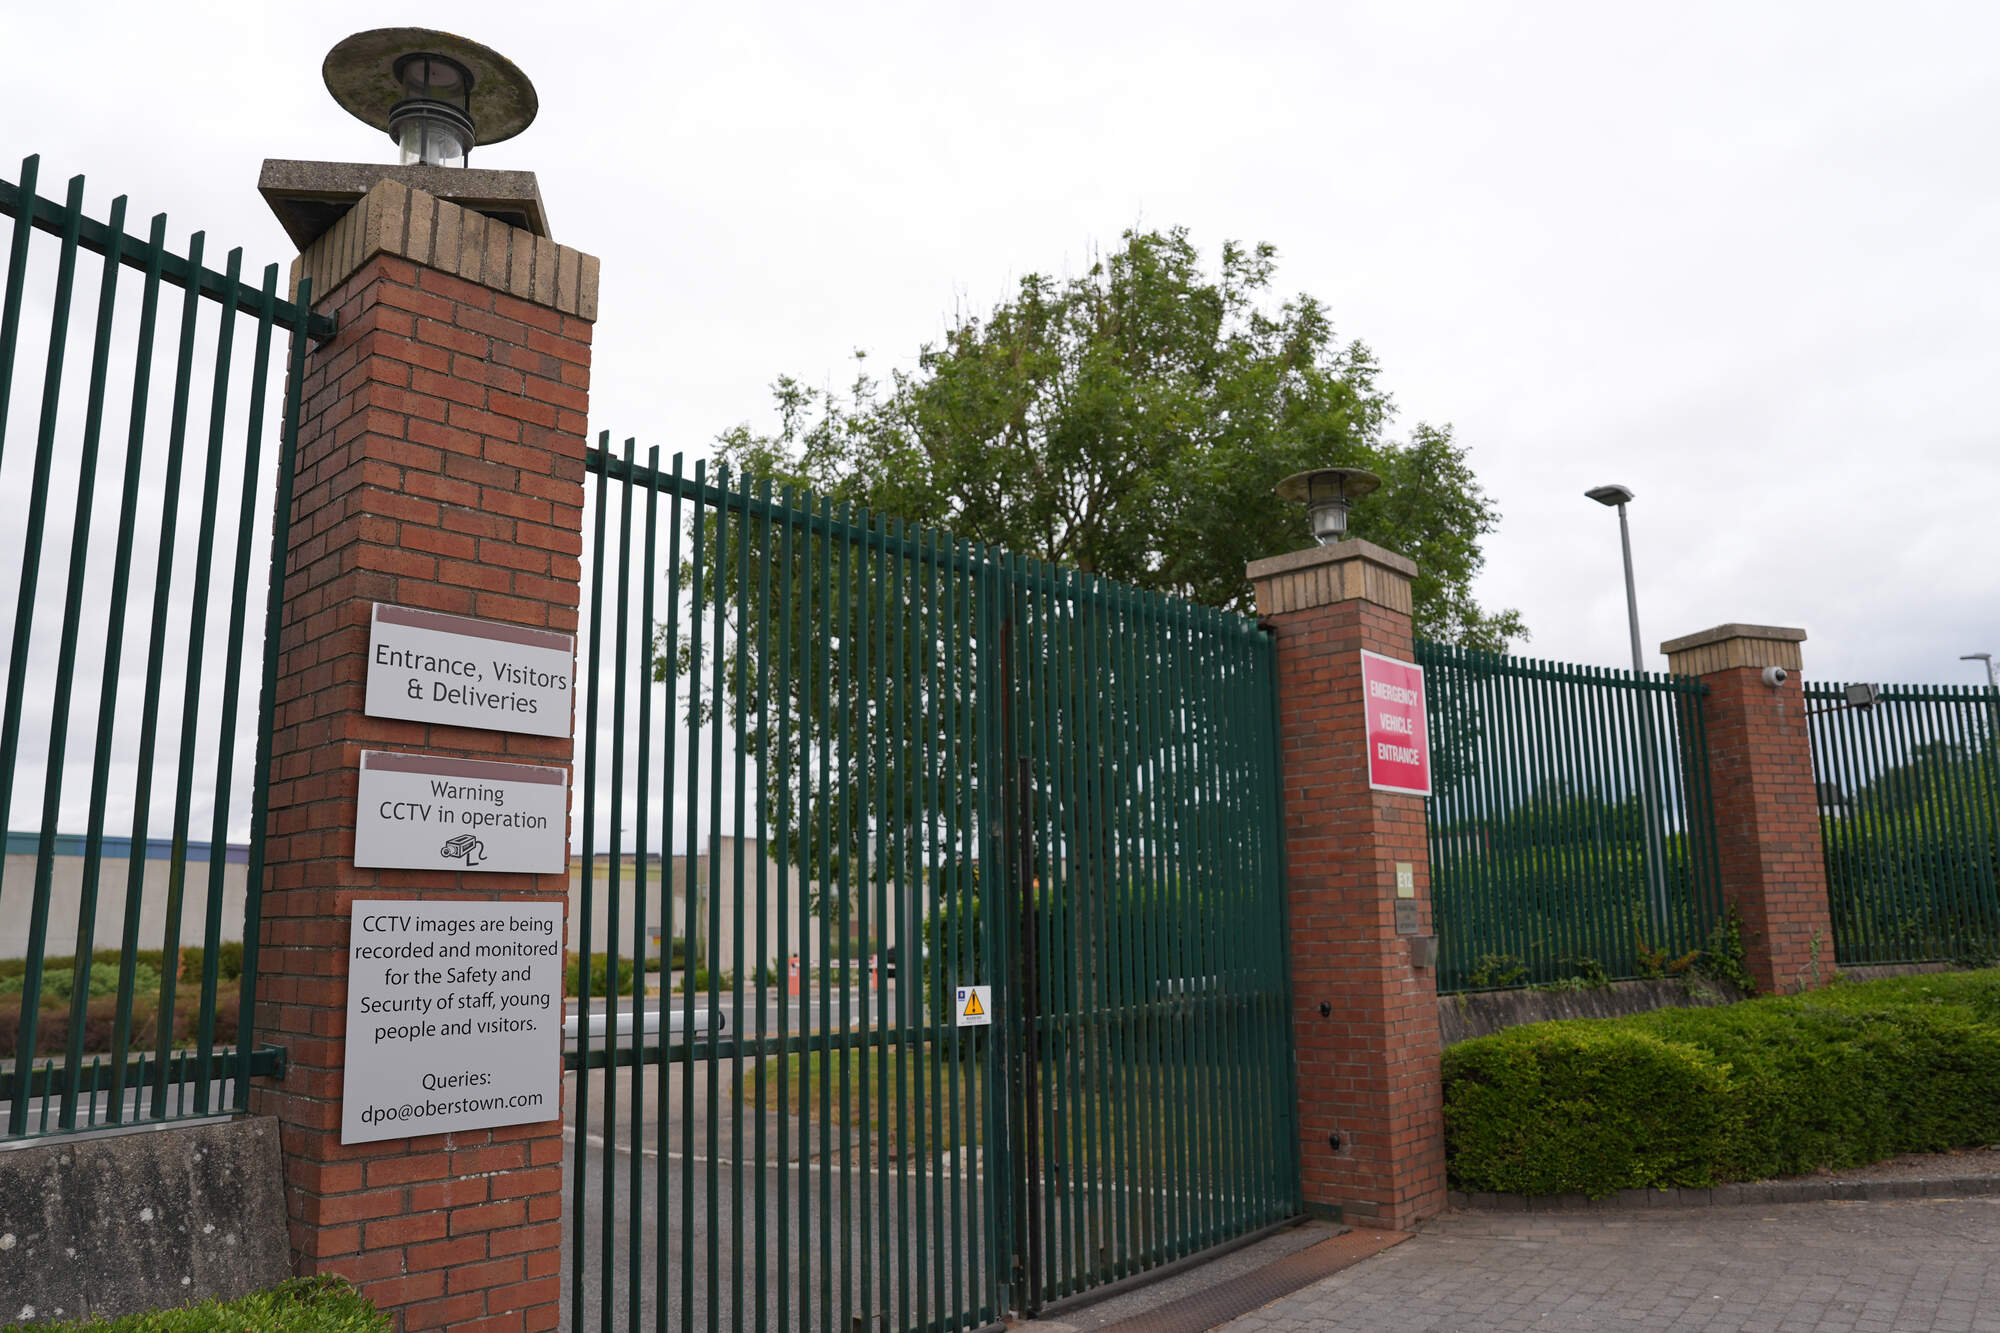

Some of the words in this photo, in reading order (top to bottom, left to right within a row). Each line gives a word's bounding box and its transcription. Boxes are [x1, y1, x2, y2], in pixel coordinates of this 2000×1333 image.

[376, 644, 482, 681] Entrance,
[493, 662, 566, 689] Visitors
[408, 679, 423, 699] &
[433, 682, 537, 713] Deliveries
[1370, 680, 1418, 706] EMERGENCY
[1380, 712, 1413, 735] VEHICLE
[1378, 742, 1419, 765] ENTRANCE
[431, 781, 503, 806] Warning
[380, 802, 431, 821] CCTV
[439, 806, 454, 823] in
[462, 812, 546, 829] operation
[363, 916, 411, 932] CCTV
[416, 916, 475, 936] images
[480, 920, 504, 931] are
[510, 916, 552, 935] being
[356, 942, 433, 959] recorded
[439, 941, 470, 957] and
[476, 940, 557, 957] monitored
[385, 968, 409, 985] for
[414, 968, 441, 984] the
[447, 967, 497, 986] Safety
[502, 965, 530, 981] and
[361, 997, 432, 1015] Security
[437, 993, 454, 1009] of
[458, 991, 495, 1009] staff,
[501, 994, 549, 1011] young
[375, 1021, 435, 1044] people
[441, 1019, 471, 1035] and
[477, 1017, 536, 1033] visitors.
[423, 1071, 490, 1091] Queries:
[361, 1092, 543, 1125] dpo@oberstown.com
